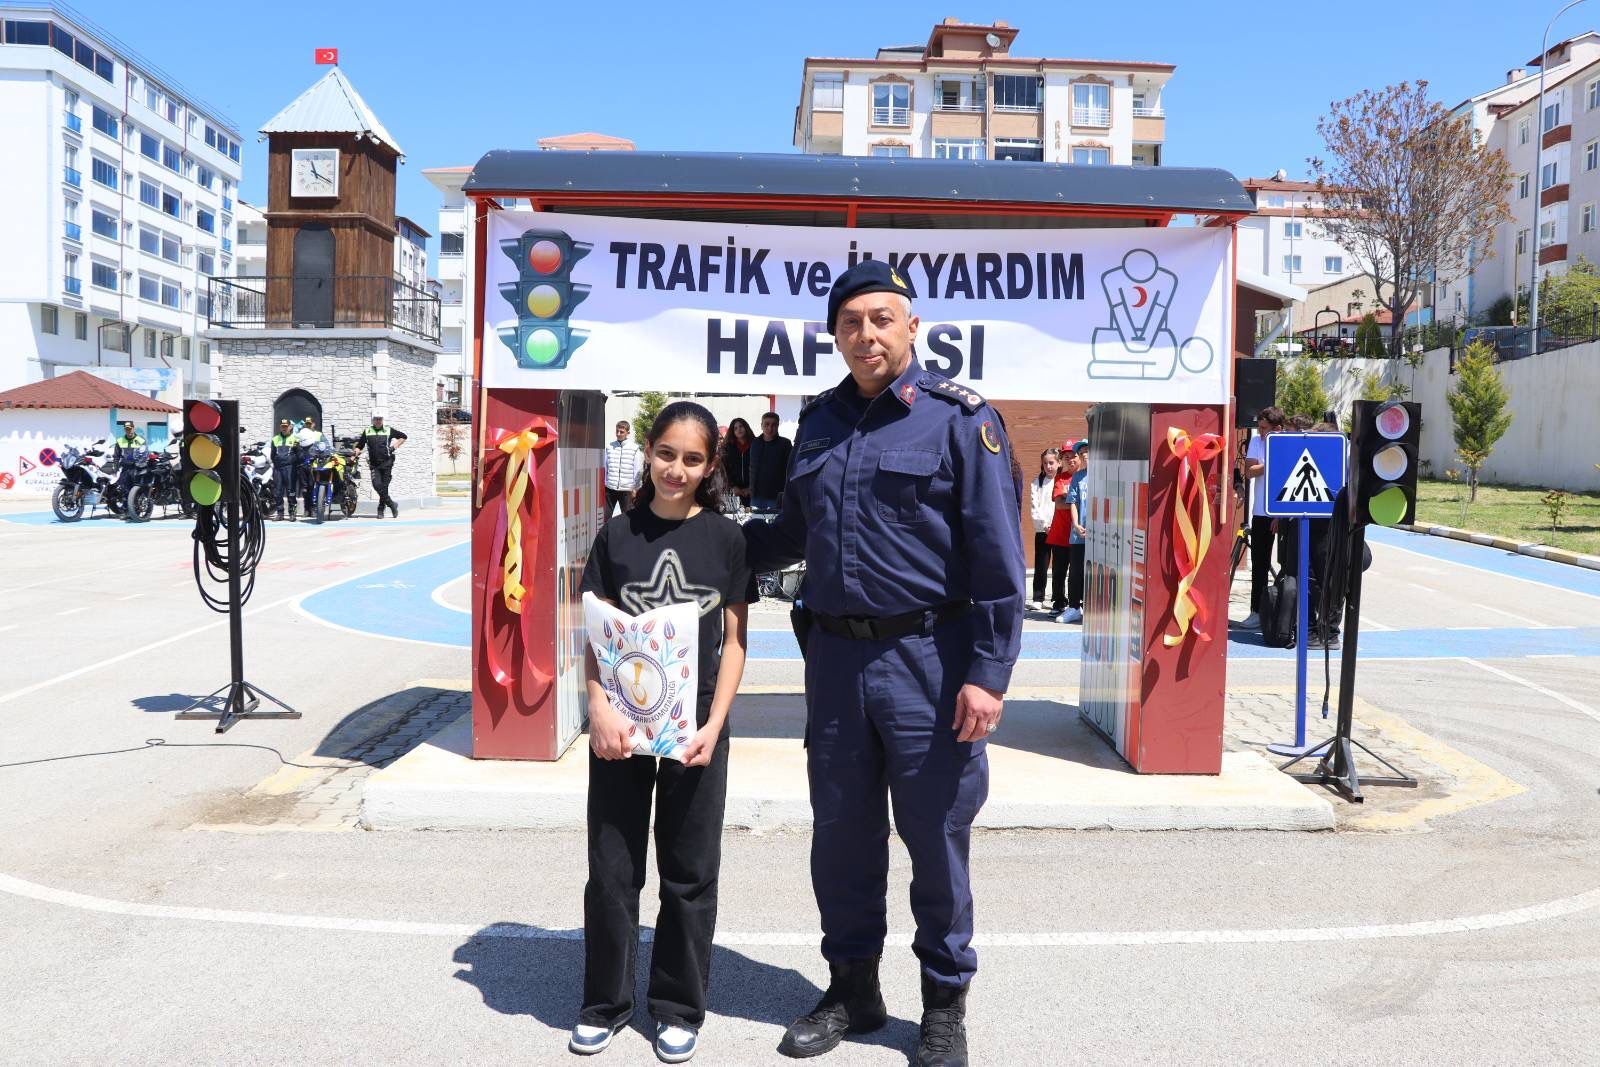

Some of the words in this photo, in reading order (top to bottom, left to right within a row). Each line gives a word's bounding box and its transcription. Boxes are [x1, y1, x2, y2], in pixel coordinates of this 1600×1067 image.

[609, 236, 771, 295] TRAFİK
[784, 261, 831, 297] ve
[848, 240, 1085, 300] İKYARDIM
[706, 318, 985, 381] HAFSI
